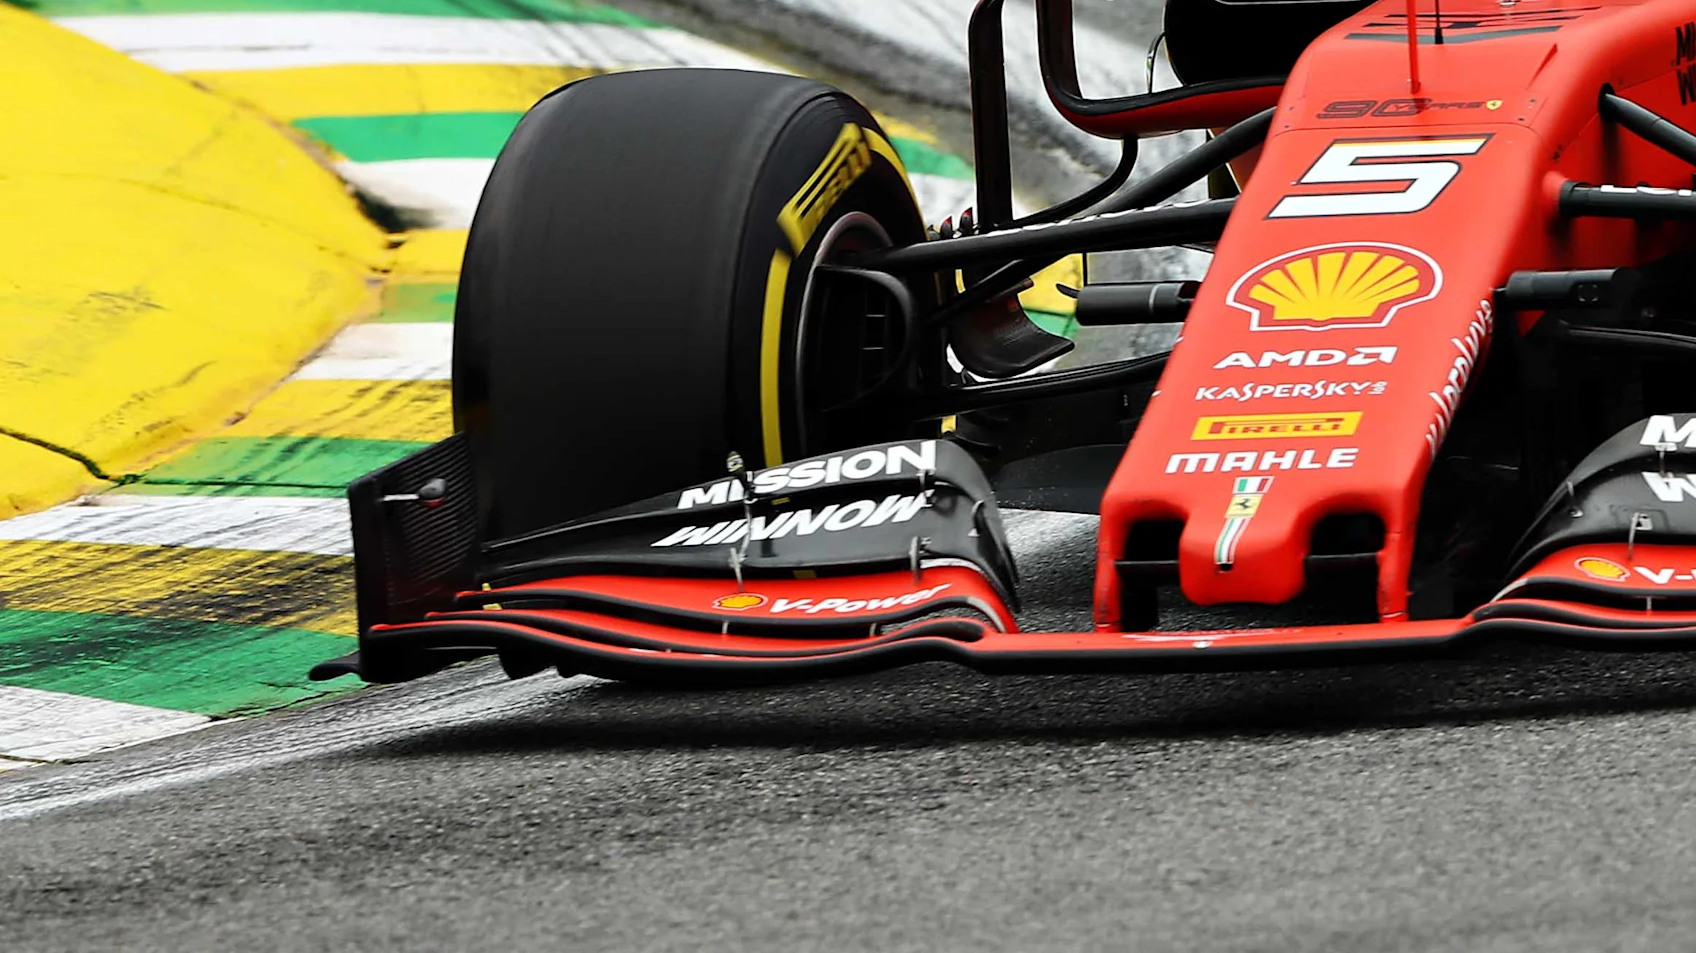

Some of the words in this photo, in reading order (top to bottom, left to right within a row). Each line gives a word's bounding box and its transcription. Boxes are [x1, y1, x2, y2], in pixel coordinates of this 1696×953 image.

[1262, 134, 1498, 220] 5
[1213, 348, 1346, 370] AMD
[1195, 380, 1371, 402] KASPERSKY
[1208, 418, 1345, 435] PIRELLI
[677, 440, 936, 509] MISSION
[1166, 448, 1359, 474] MAHLE
[651, 489, 935, 547] WINNOW
[770, 583, 952, 614] V-Power
